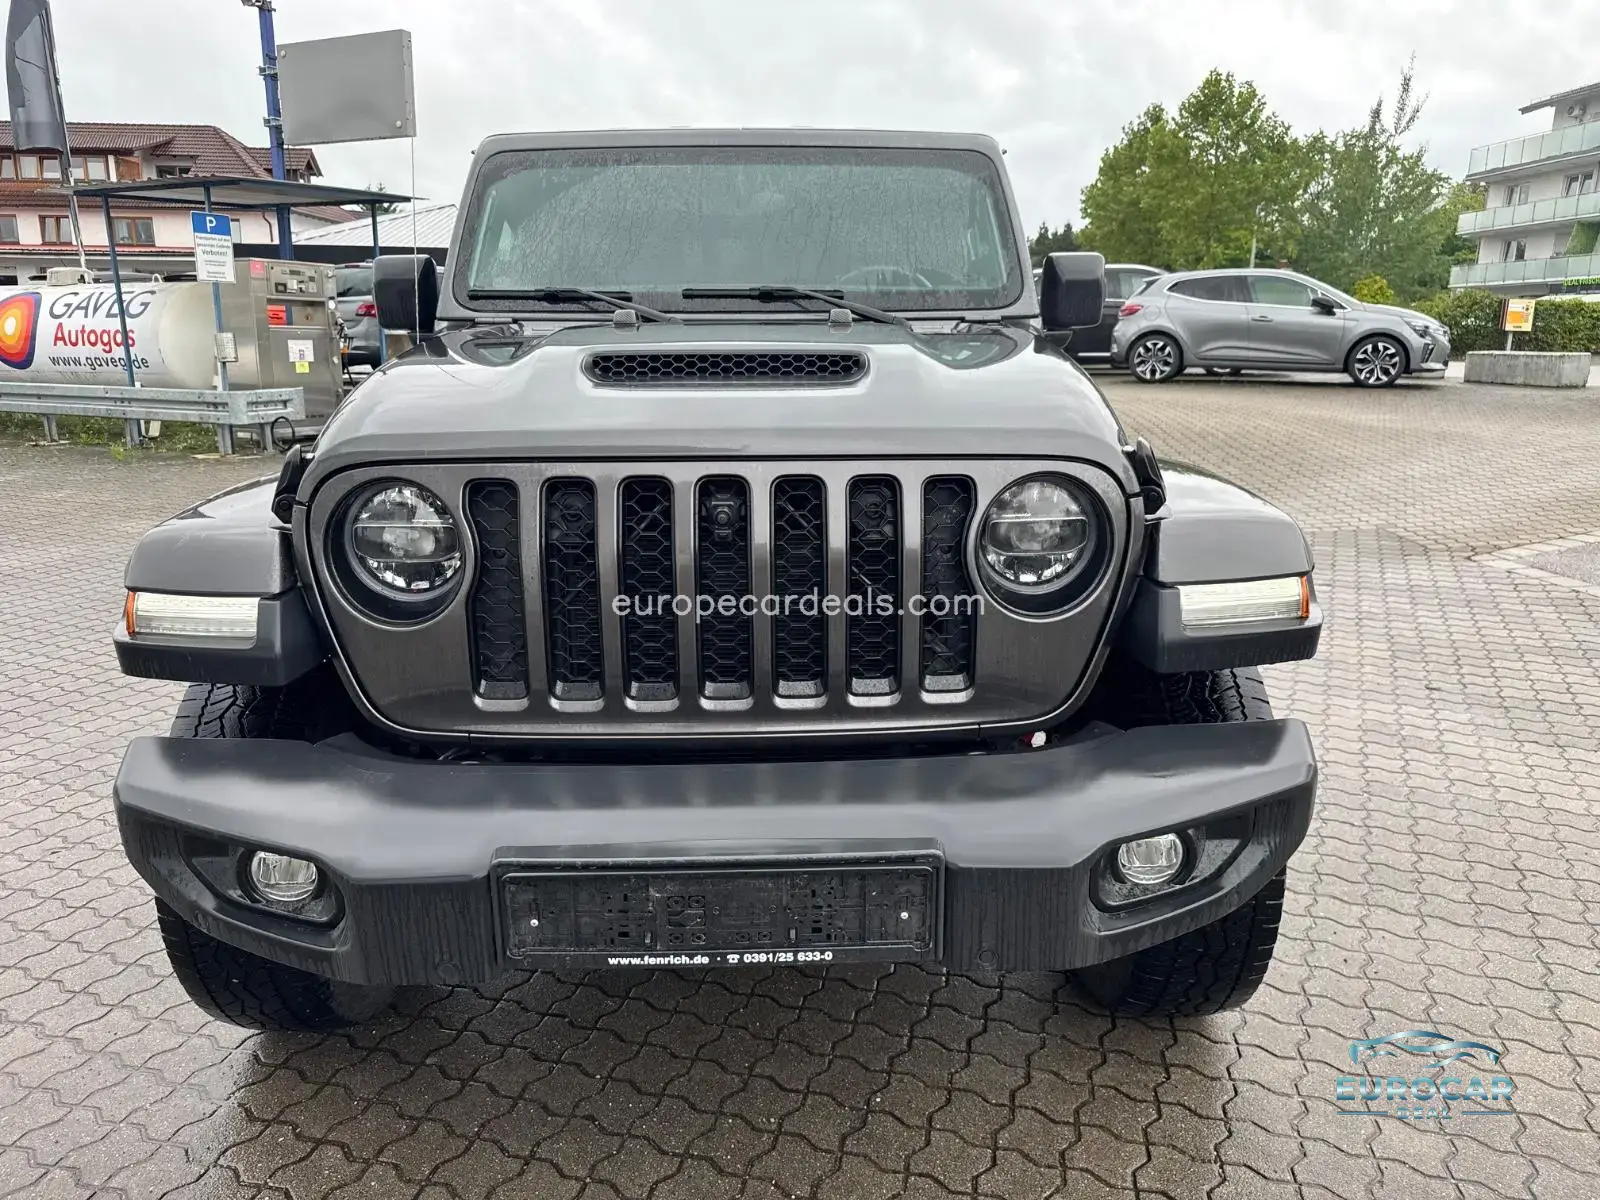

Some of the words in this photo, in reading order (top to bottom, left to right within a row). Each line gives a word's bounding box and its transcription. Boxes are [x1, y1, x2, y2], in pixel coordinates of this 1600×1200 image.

[206, 216, 216, 233] P
[201, 248, 228, 257] Verboten!
[49, 290, 157, 320] GAVEG
[53, 322, 136, 354] Autogas
[48, 354, 150, 371] www.gavegde
[608, 954, 710, 965] www.fenrich.de
[743, 951, 794, 964] 0391/25
[797, 951, 833, 962] 633-0
